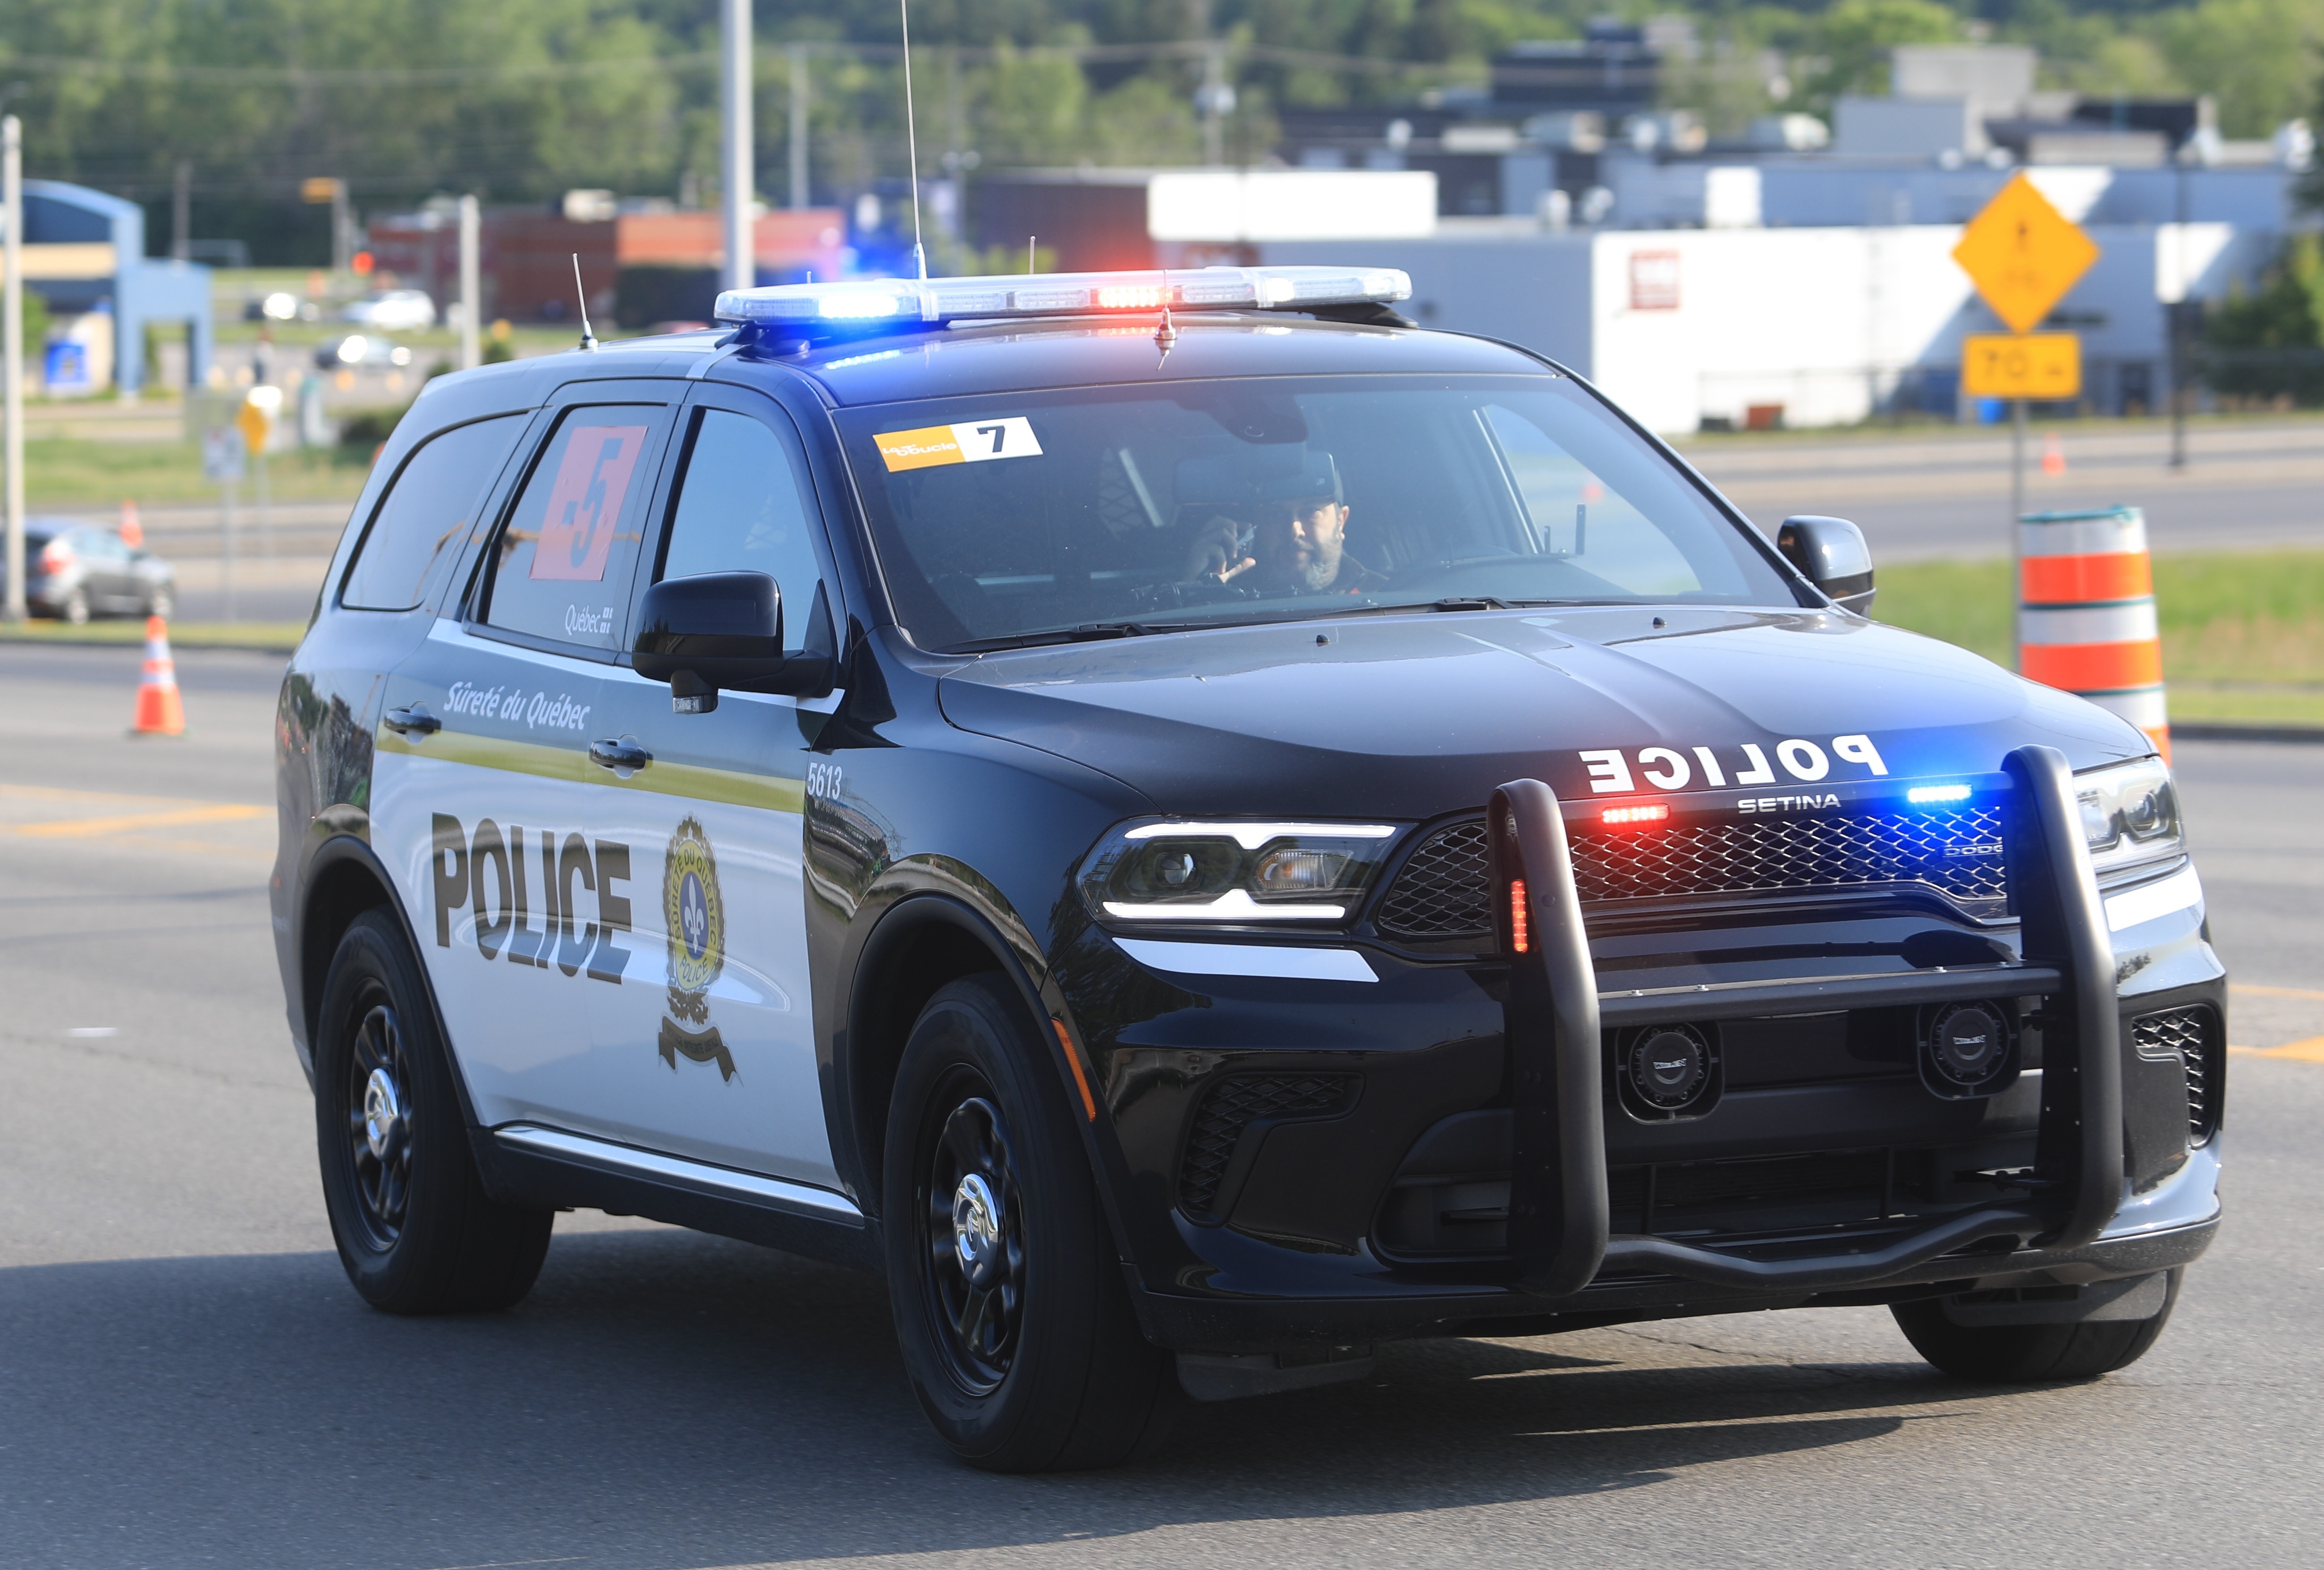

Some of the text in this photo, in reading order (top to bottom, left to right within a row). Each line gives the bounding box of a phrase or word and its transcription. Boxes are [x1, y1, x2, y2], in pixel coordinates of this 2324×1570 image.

[976, 425, 1006, 453] 7
[565, 604, 601, 636] Québec
[444, 681, 591, 730] Sûreté du Québec
[807, 762, 842, 800] 5613
[1738, 793, 1841, 814] SETINA
[684, 848, 694, 866] DU
[1944, 845, 2003, 856] DODG
[432, 812, 632, 984] POLICE
[680, 954, 708, 983] POLICE
